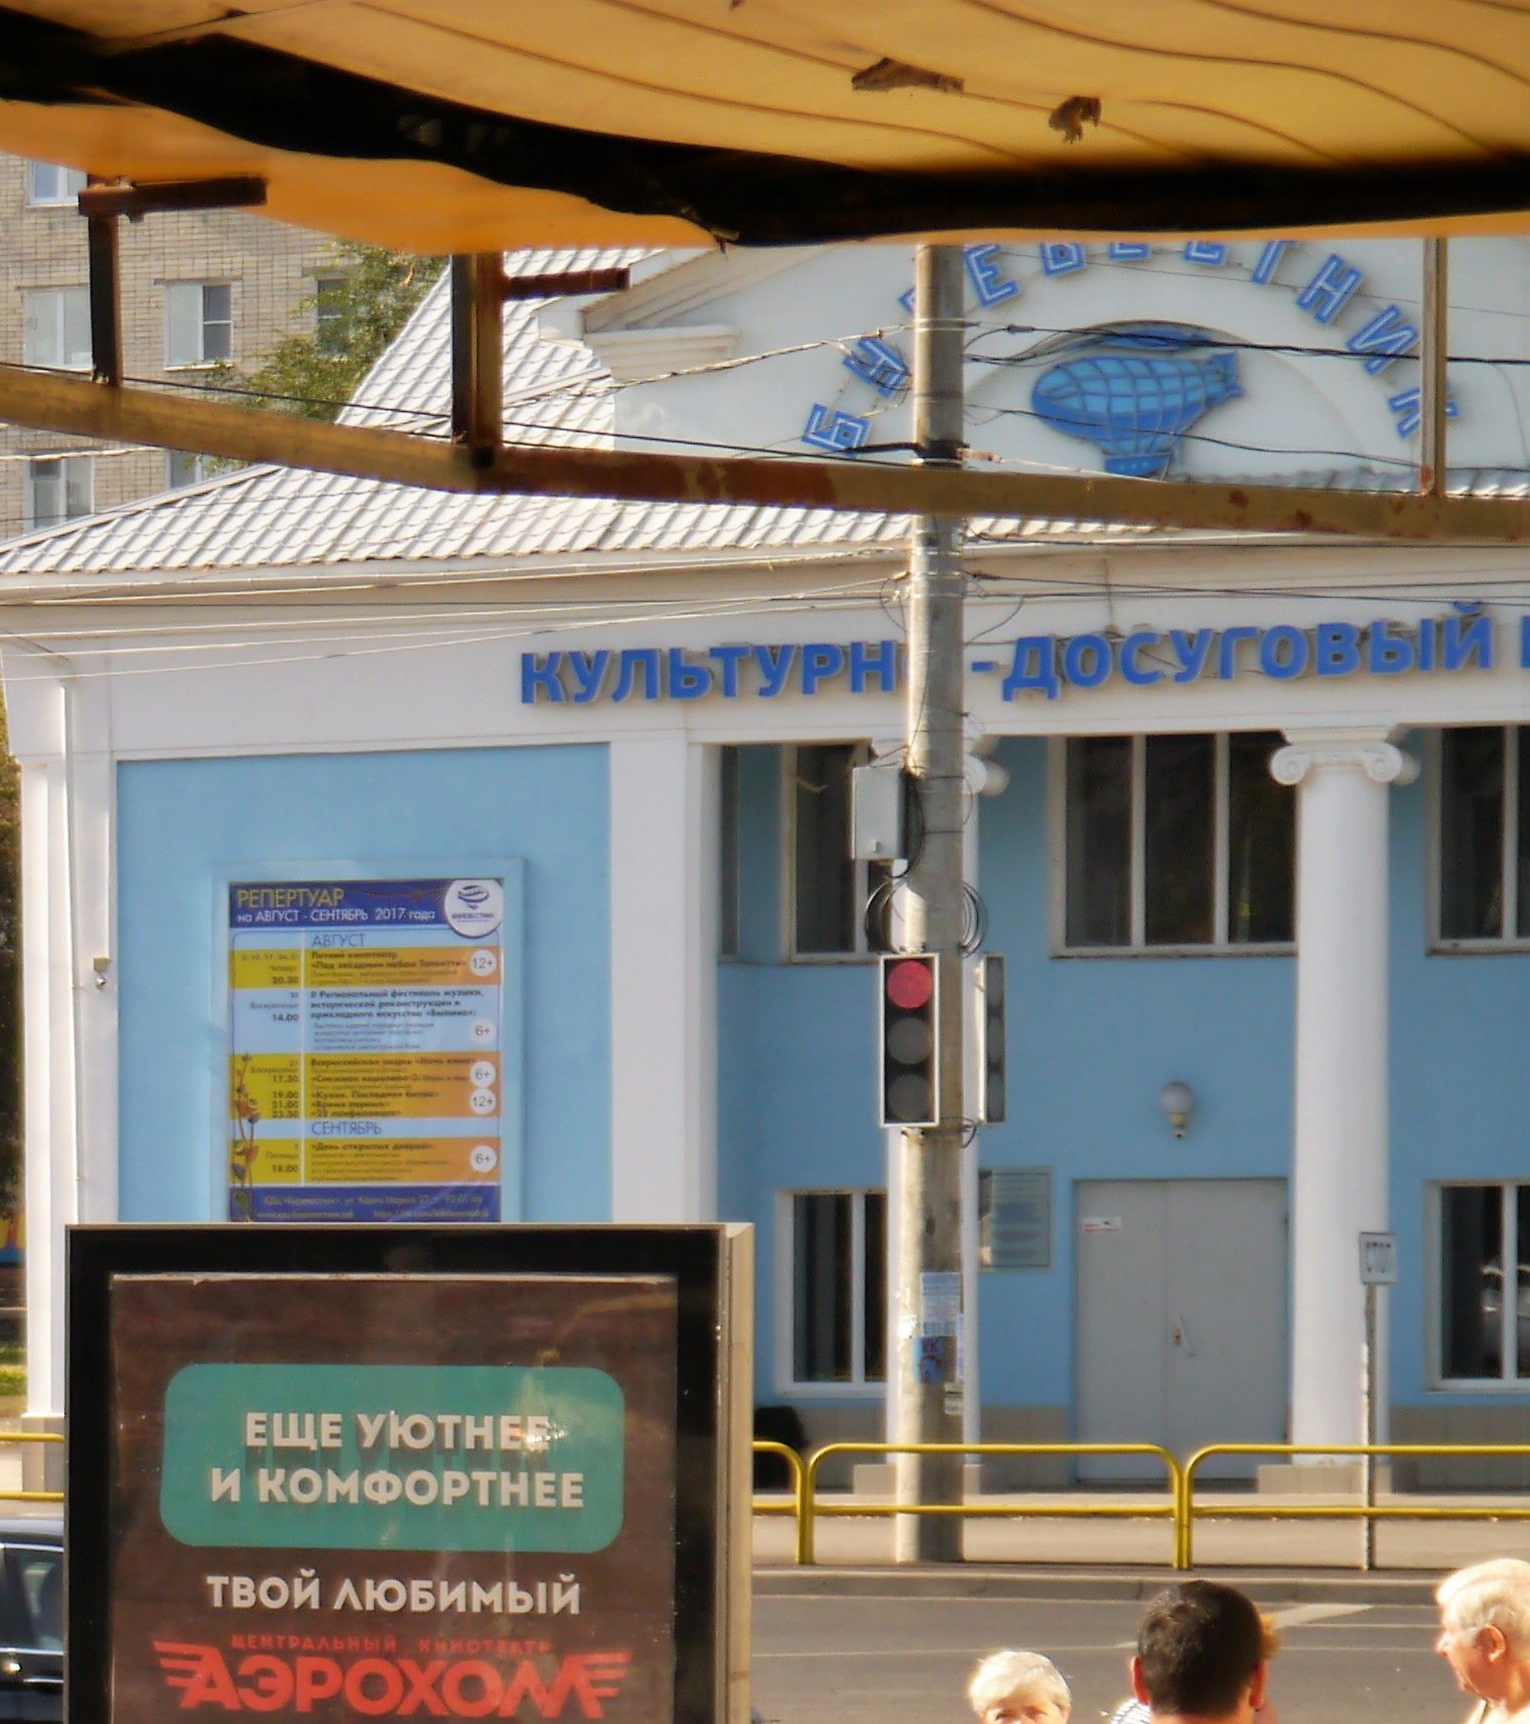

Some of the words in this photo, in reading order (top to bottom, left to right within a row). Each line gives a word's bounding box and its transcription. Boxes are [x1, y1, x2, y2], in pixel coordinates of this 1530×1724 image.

[521, 599, 1492, 704] КУЛЬТУРН-ДОСУГОВЫЙ
[238, 887, 344, 908] РЕПЕРТУАР
[256, 909, 299, 922] АВГУСТ
[310, 908, 369, 922] СЕНТЯБРЬ
[312, 934, 366, 947] АВГУСТ
[473, 957, 493, 969] 12+
[475, 1025, 491, 1037] 6+
[475, 1068, 491, 1080] 6+
[473, 1095, 493, 1108] 12+
[311, 1120, 382, 1136] СЕНТЯБРЬ
[475, 1152, 491, 1164] 6+
[246, 1411, 344, 1452] ЕЩЕ
[355, 1413, 552, 1452] УЮТНЕЕ
[211, 1467, 242, 1502] И
[258, 1467, 585, 1508] КОМФОРТНЕЕ
[206, 1567, 321, 1610] ТВОЙ
[333, 1571, 581, 1615] ЛЮБИМЫЙ
[230, 1633, 397, 1653] ЦЕНТРАЛЬНЫЙ
